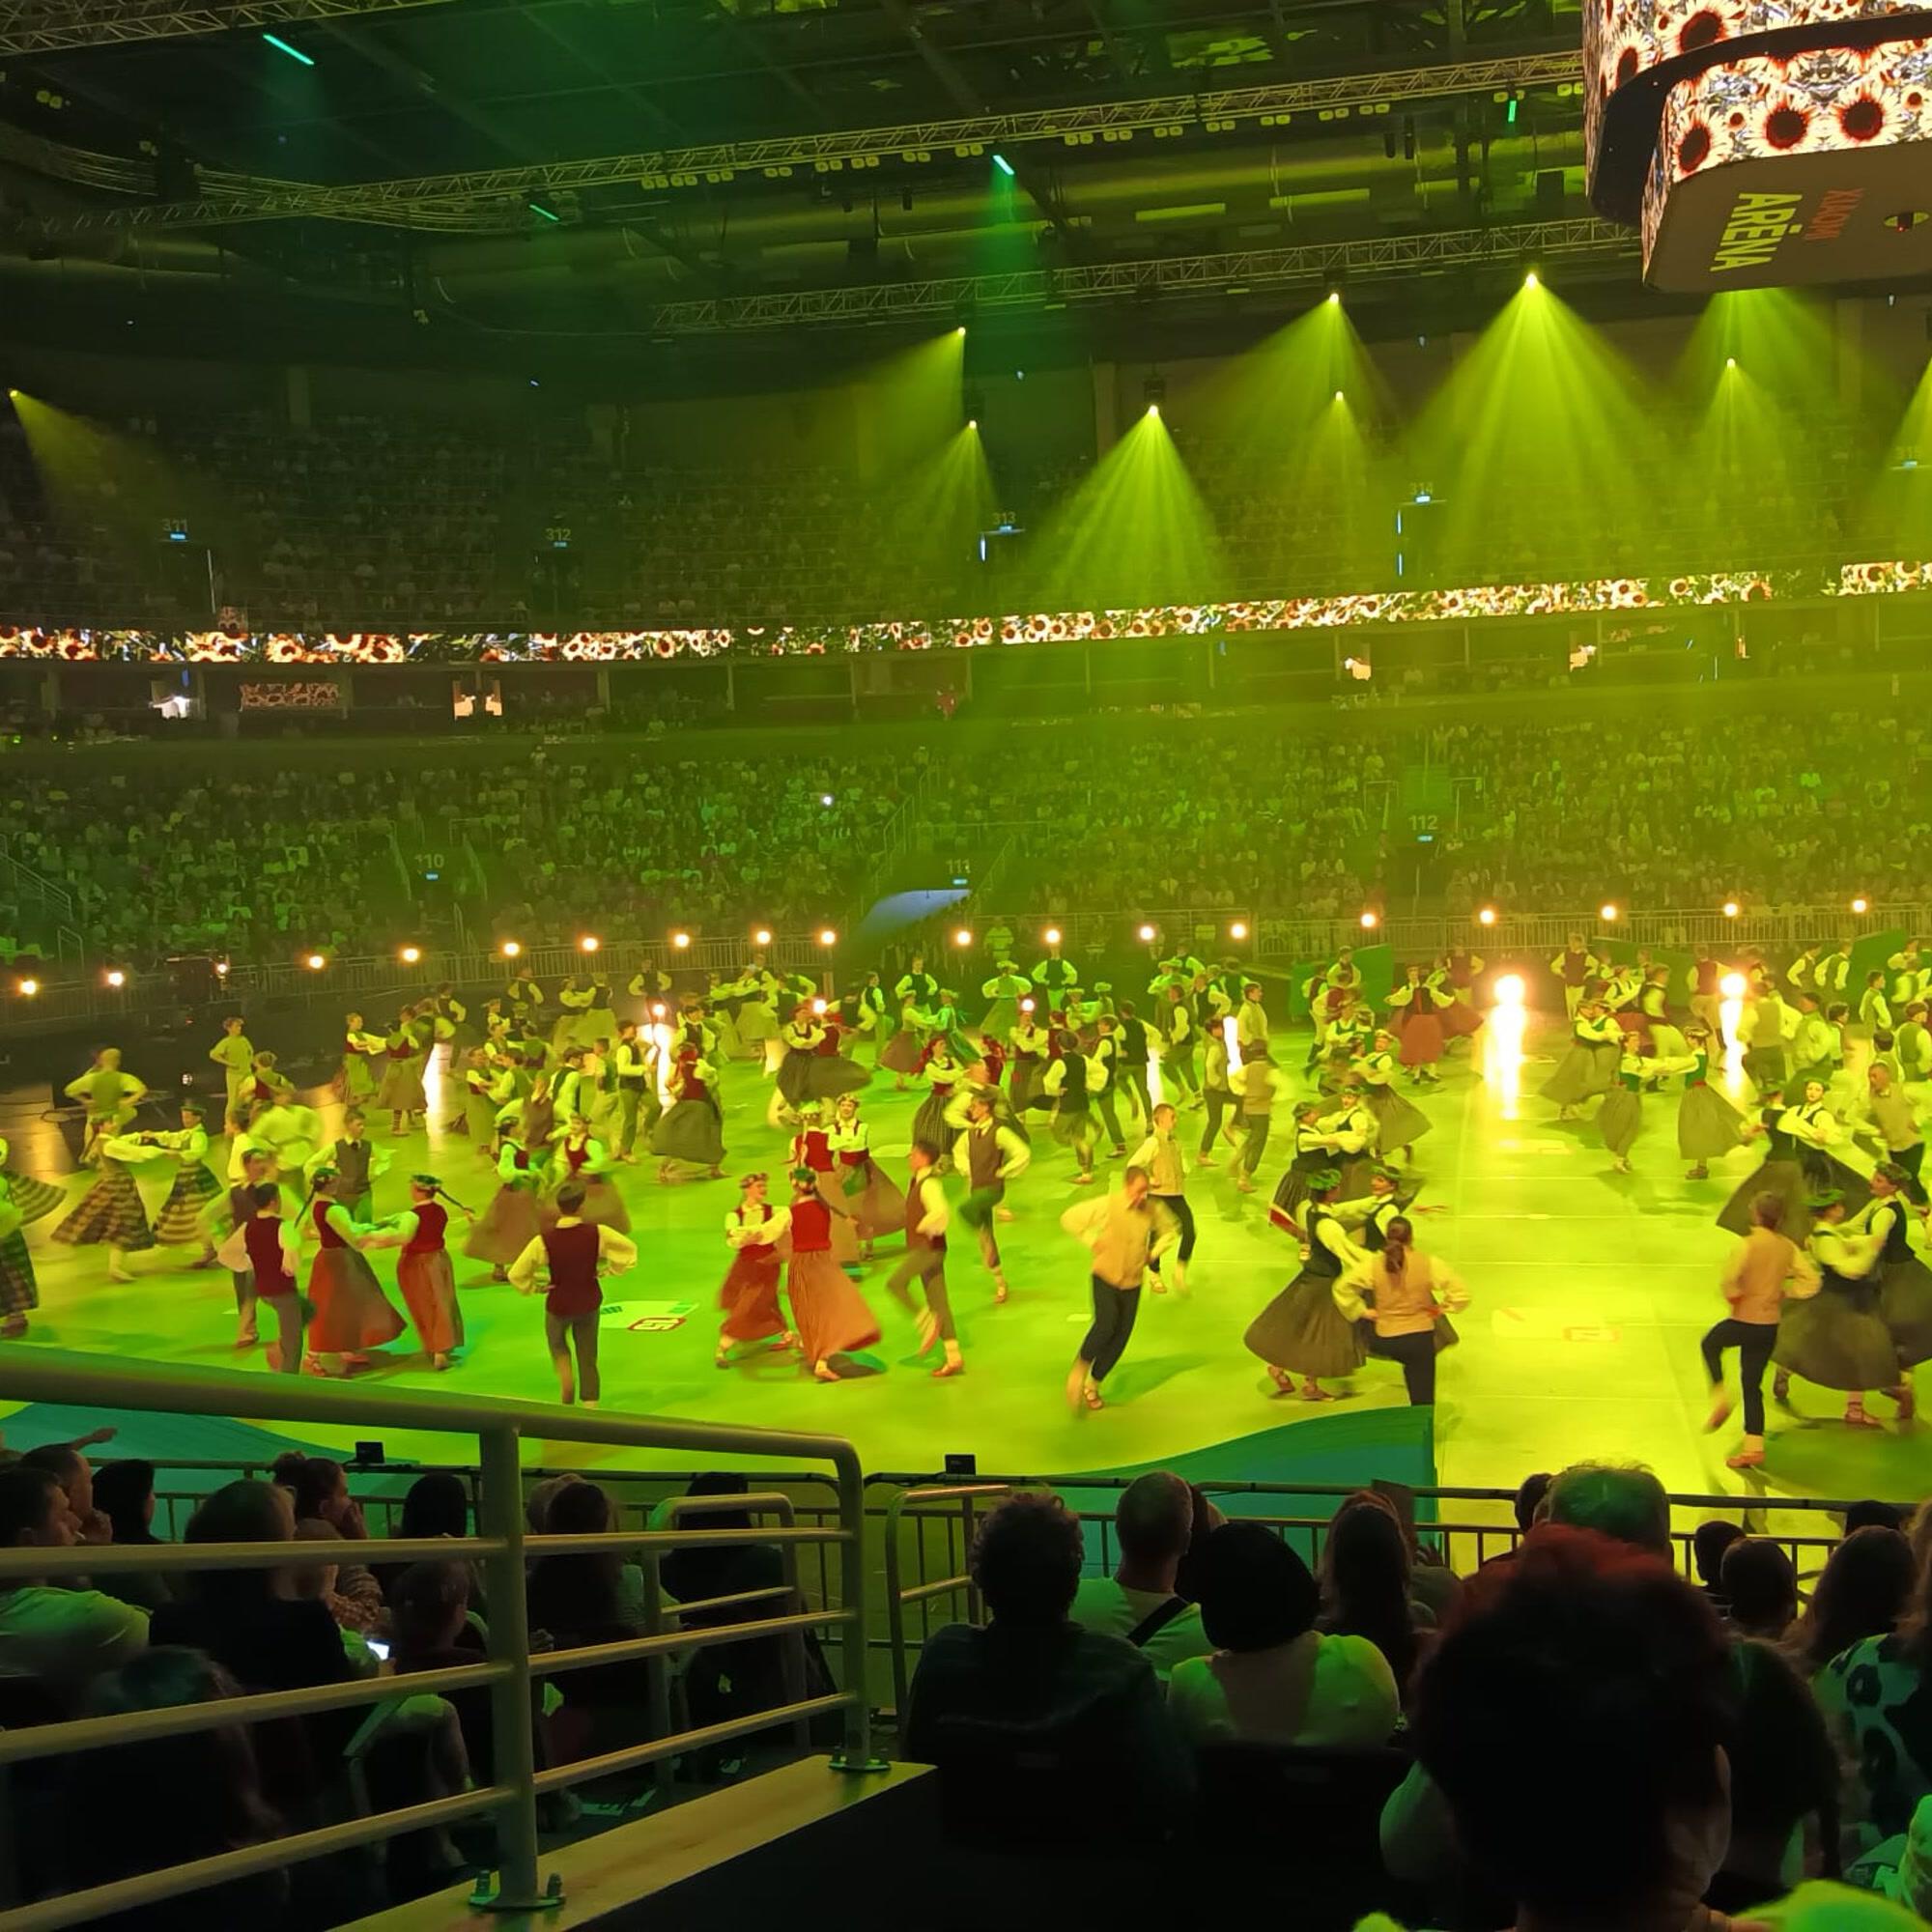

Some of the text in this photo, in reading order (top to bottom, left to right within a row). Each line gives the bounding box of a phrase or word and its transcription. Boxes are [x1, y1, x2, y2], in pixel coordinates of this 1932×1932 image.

[162, 518, 187, 532] 311
[992, 512, 1016, 526] 313
[545, 527, 572, 541] 312
[1408, 815, 1438, 831] 112
[414, 854, 444, 869] 110
[946, 859, 971, 874] 111
